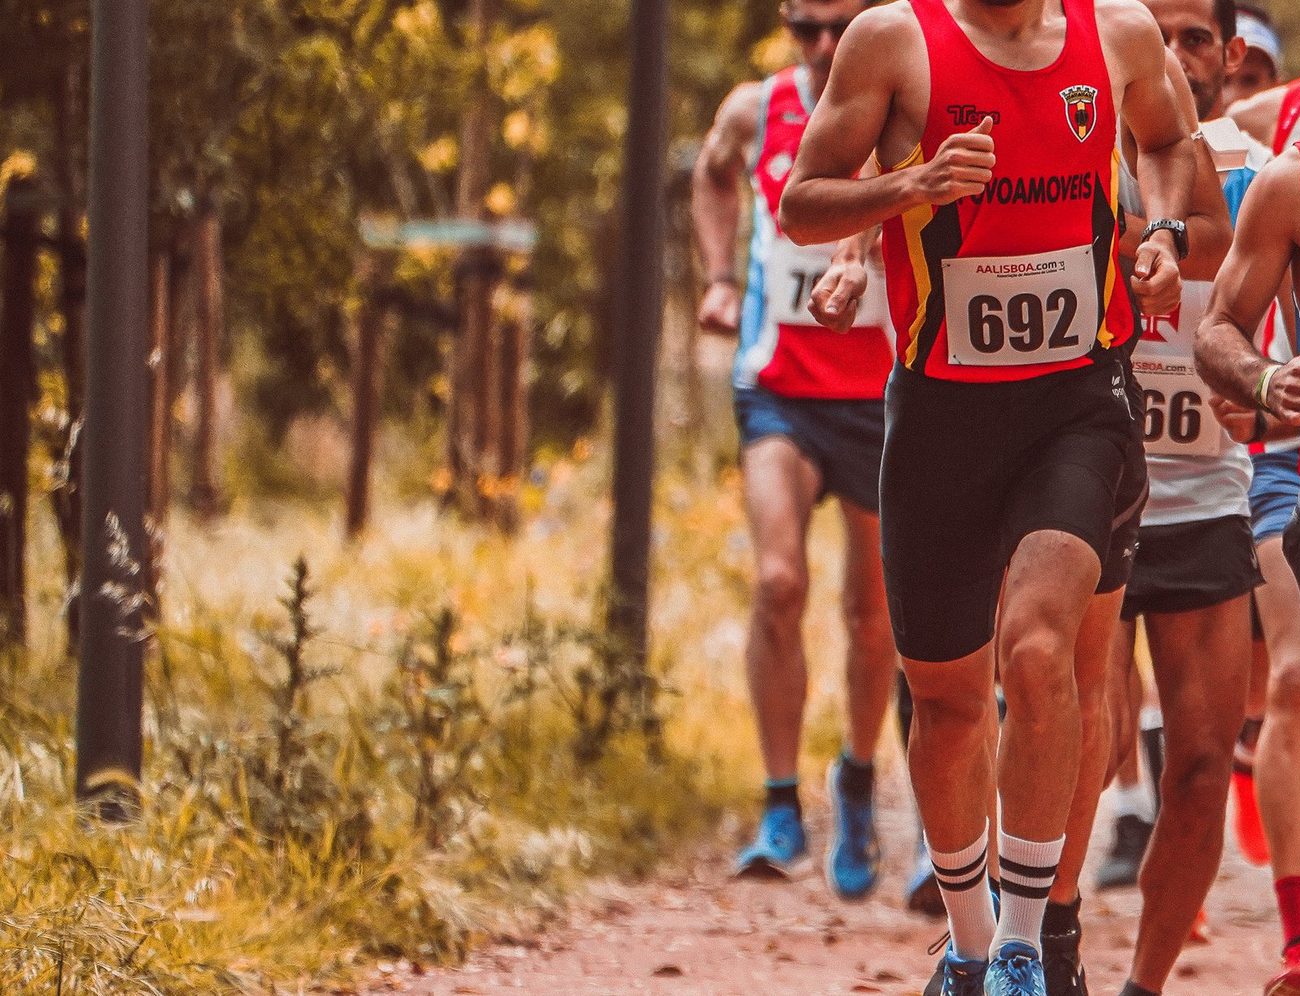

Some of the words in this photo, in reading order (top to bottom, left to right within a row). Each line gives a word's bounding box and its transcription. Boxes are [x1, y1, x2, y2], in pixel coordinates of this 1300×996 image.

[957, 171, 1092, 205] VOAMOVEIS
[976, 261, 1057, 273] AALISBOA.com
[968, 288, 1079, 354] 692
